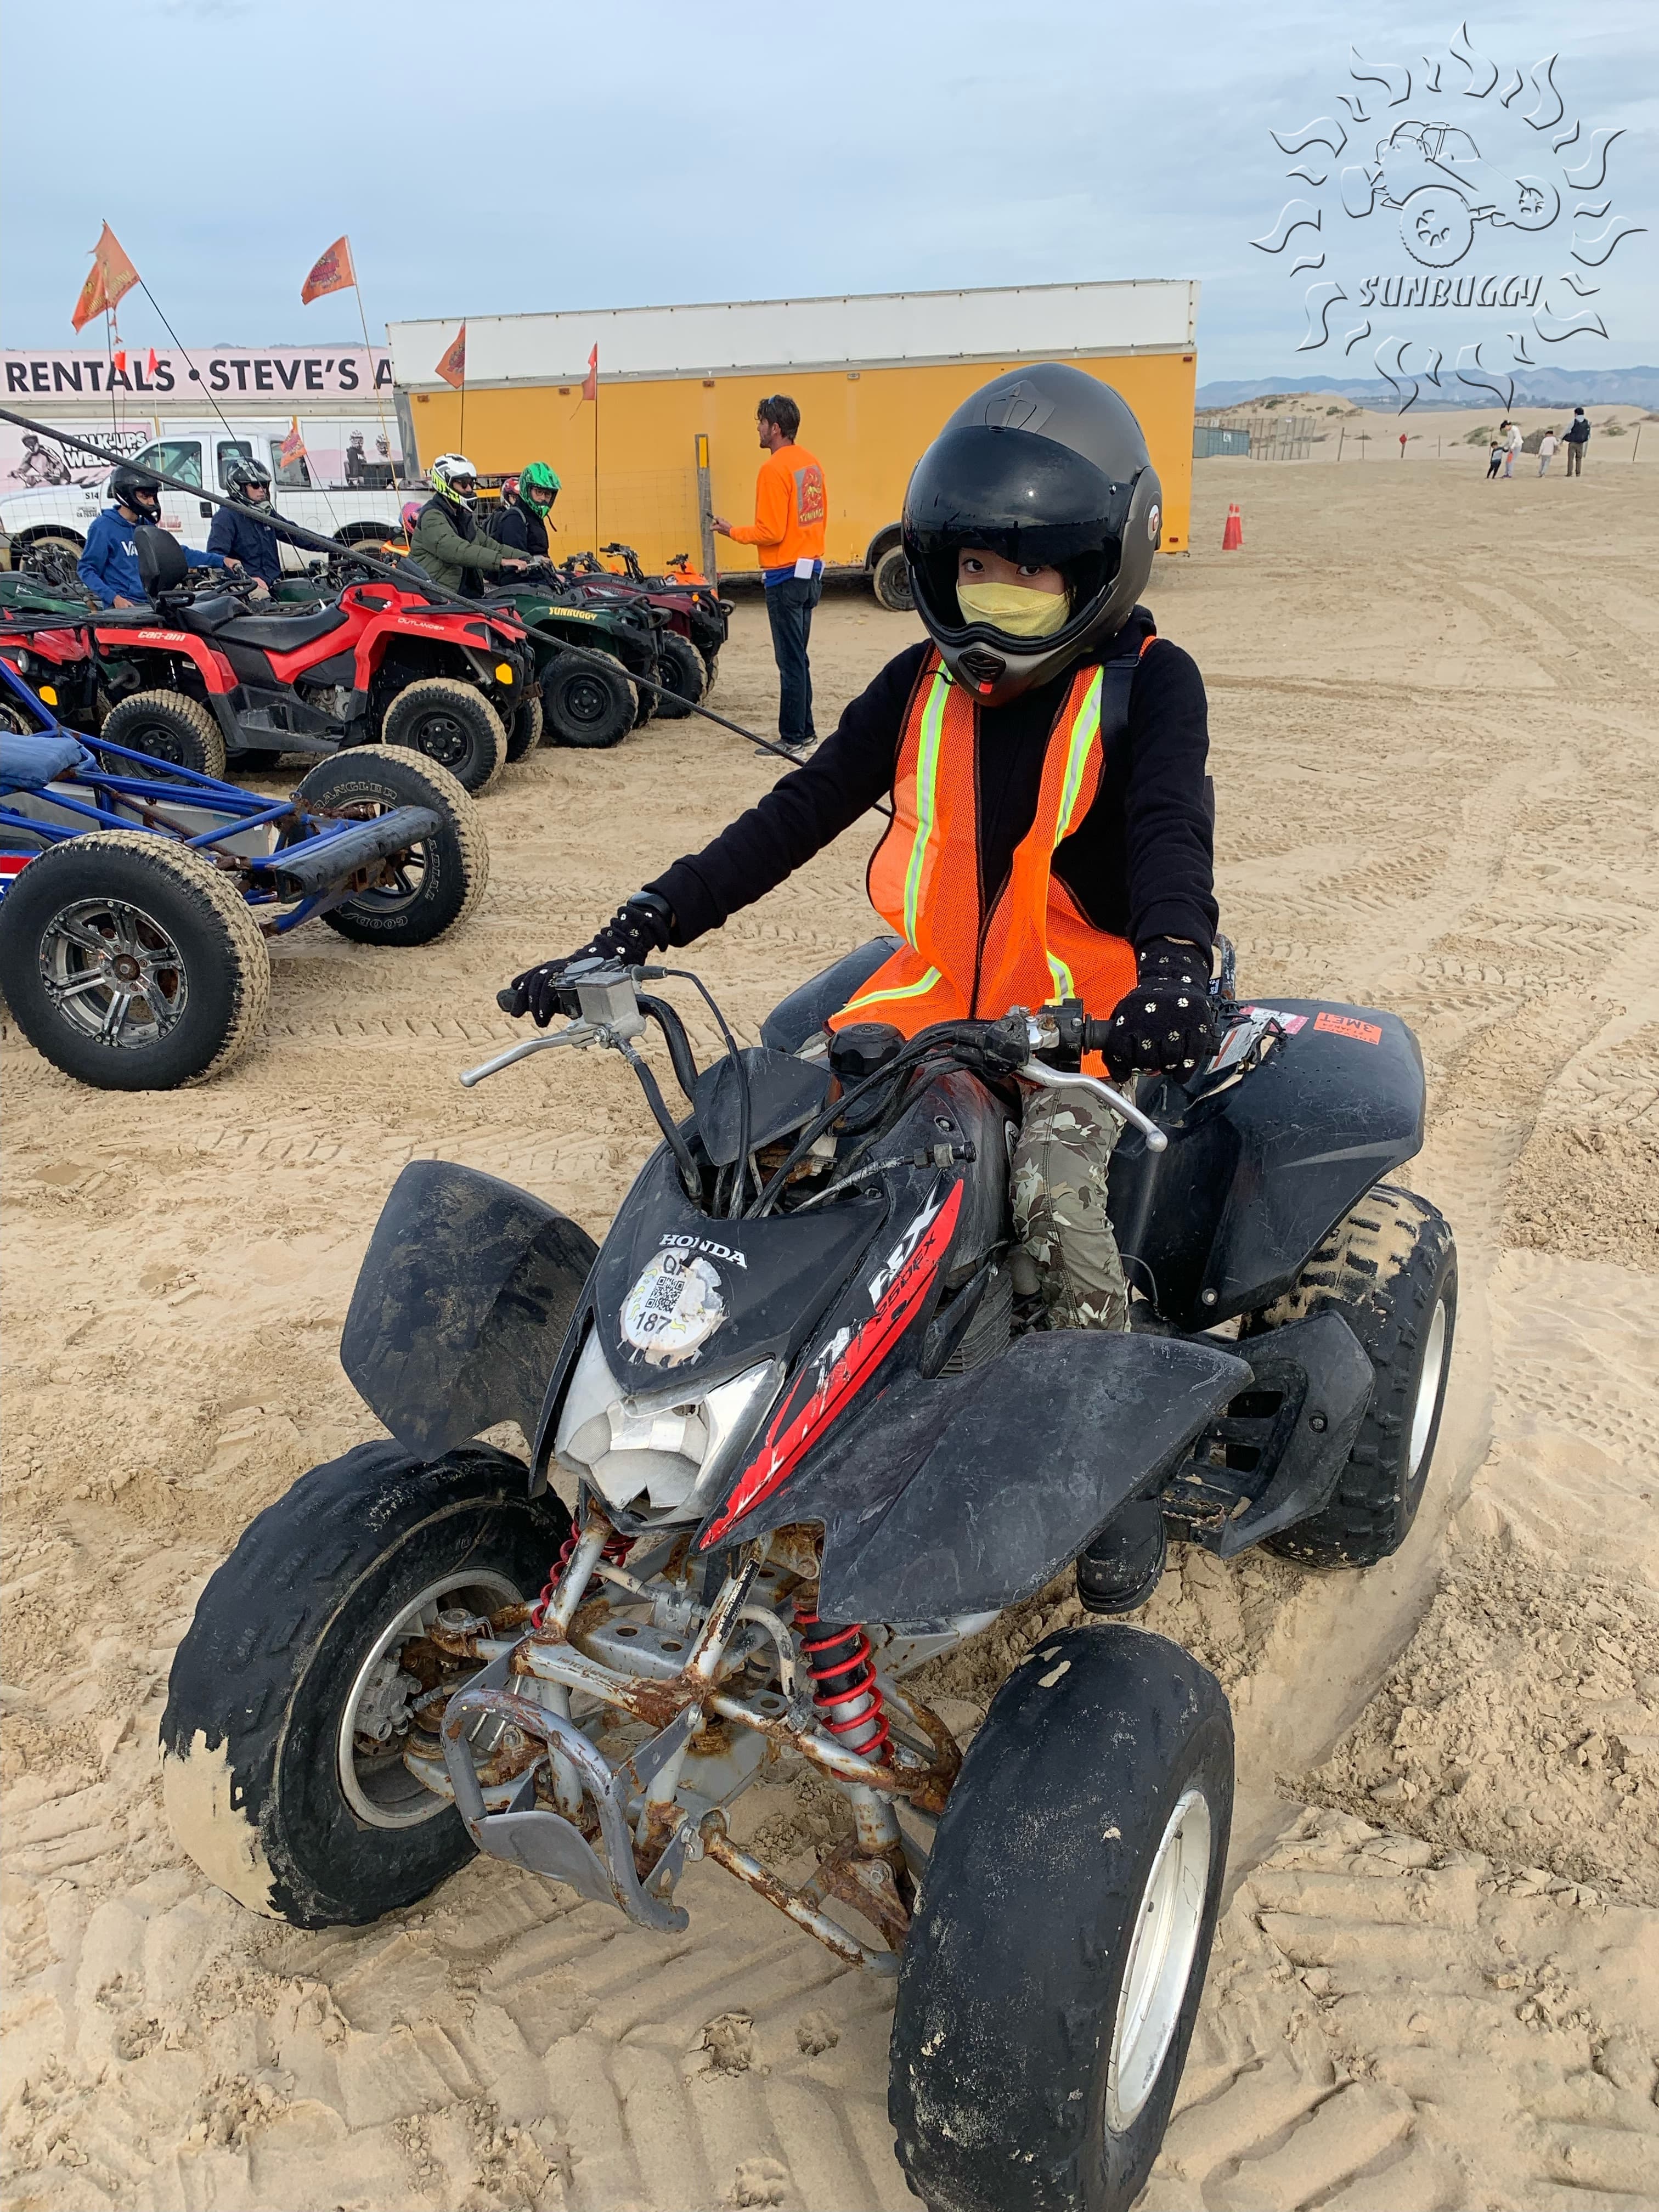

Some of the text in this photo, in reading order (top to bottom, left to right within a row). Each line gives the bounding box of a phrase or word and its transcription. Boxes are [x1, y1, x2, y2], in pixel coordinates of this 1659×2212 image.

[5, 360, 175, 392] RENTALS
[208, 358, 359, 391] STEVE'S
[121, 540, 138, 556] VA
[397, 618, 445, 631] OUTLANDER
[549, 606, 598, 622] SUNBUGGY
[313, 780, 398, 809] RANGLER
[658, 1234, 748, 1269] HONDA
[636, 1311, 673, 1334] 187
[731, 1595, 744, 1622] 2007
